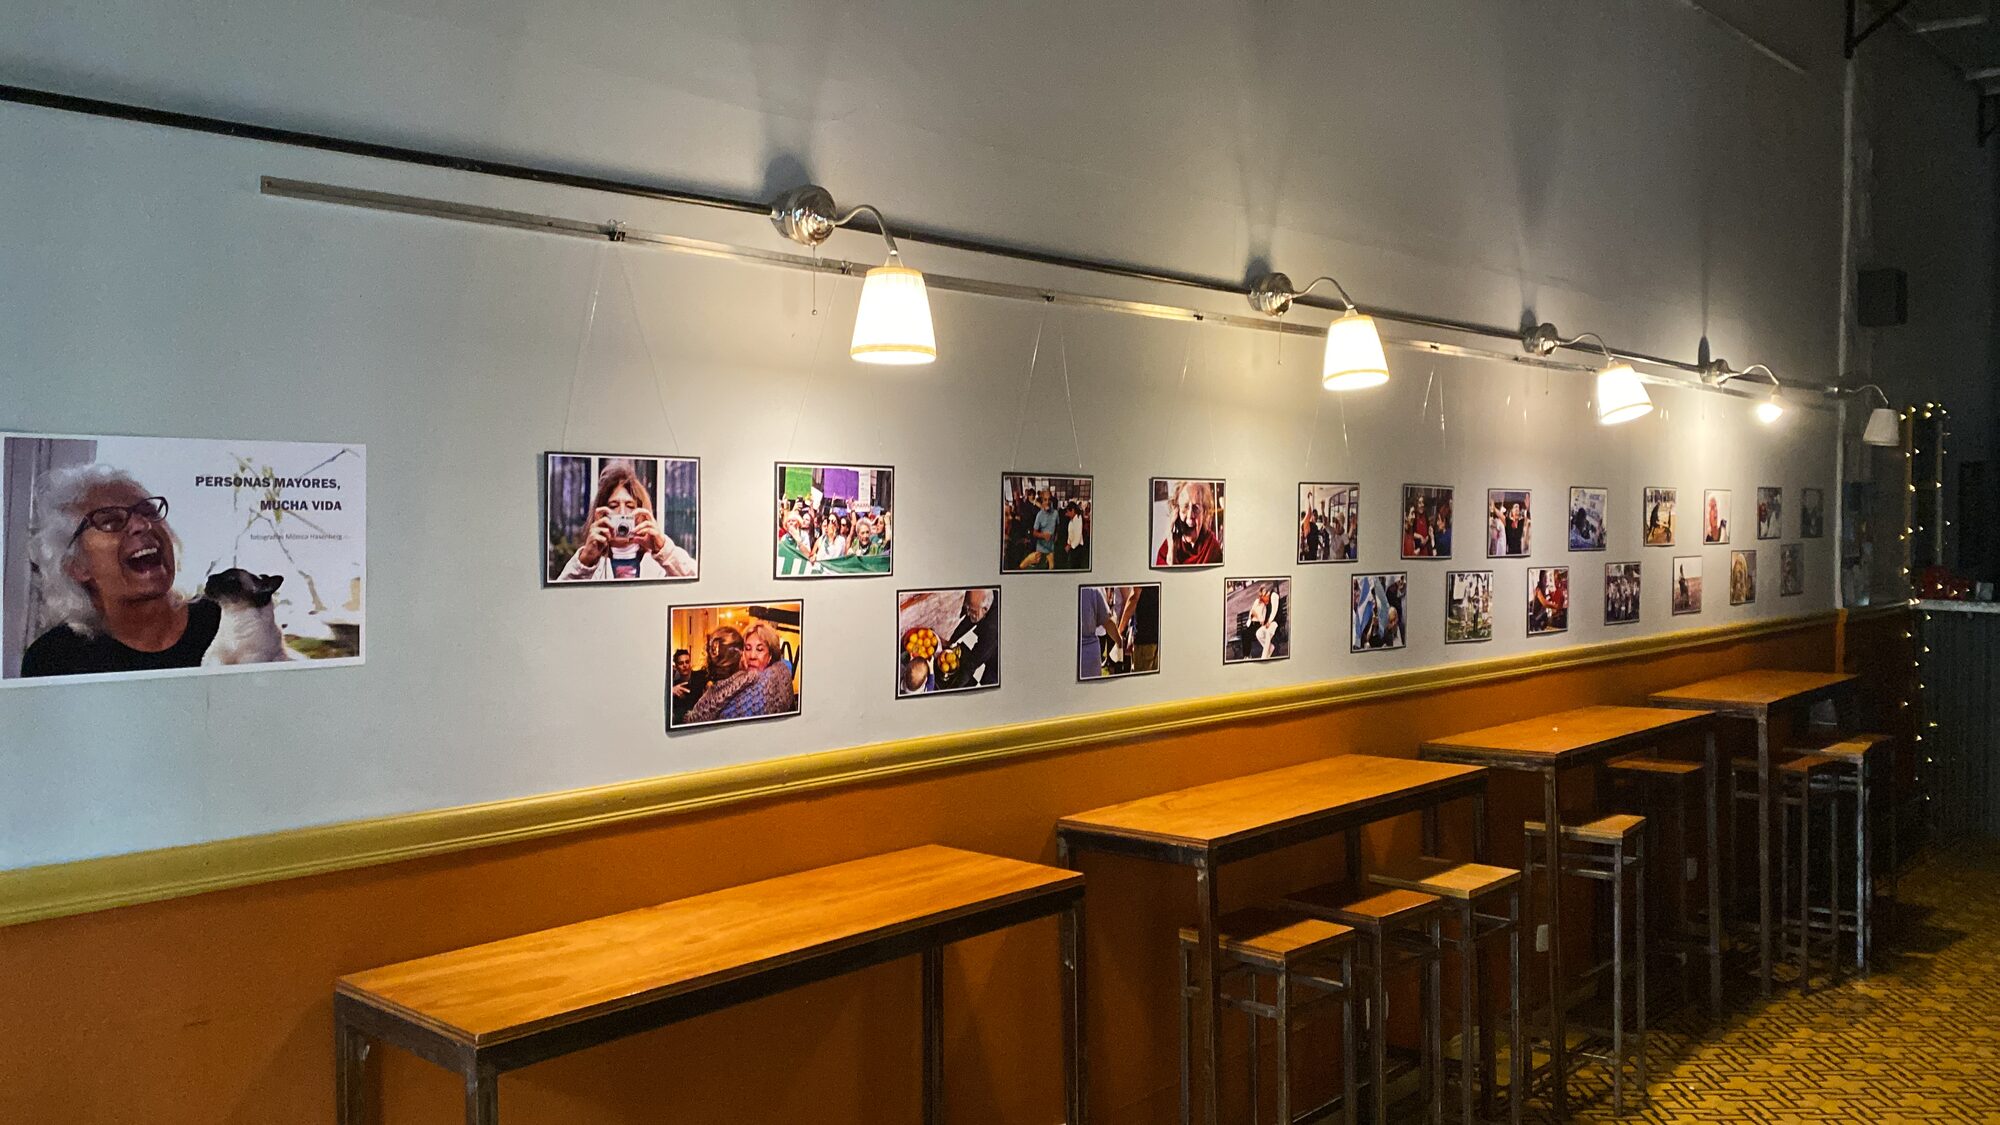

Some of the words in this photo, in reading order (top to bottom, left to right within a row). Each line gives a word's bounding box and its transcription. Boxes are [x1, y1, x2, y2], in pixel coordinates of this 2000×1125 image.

[195, 475, 271, 488] PERSONAS
[274, 478, 341, 491] MAYORES,
[260, 500, 308, 511] MUCHA
[311, 500, 342, 511] VIDA
